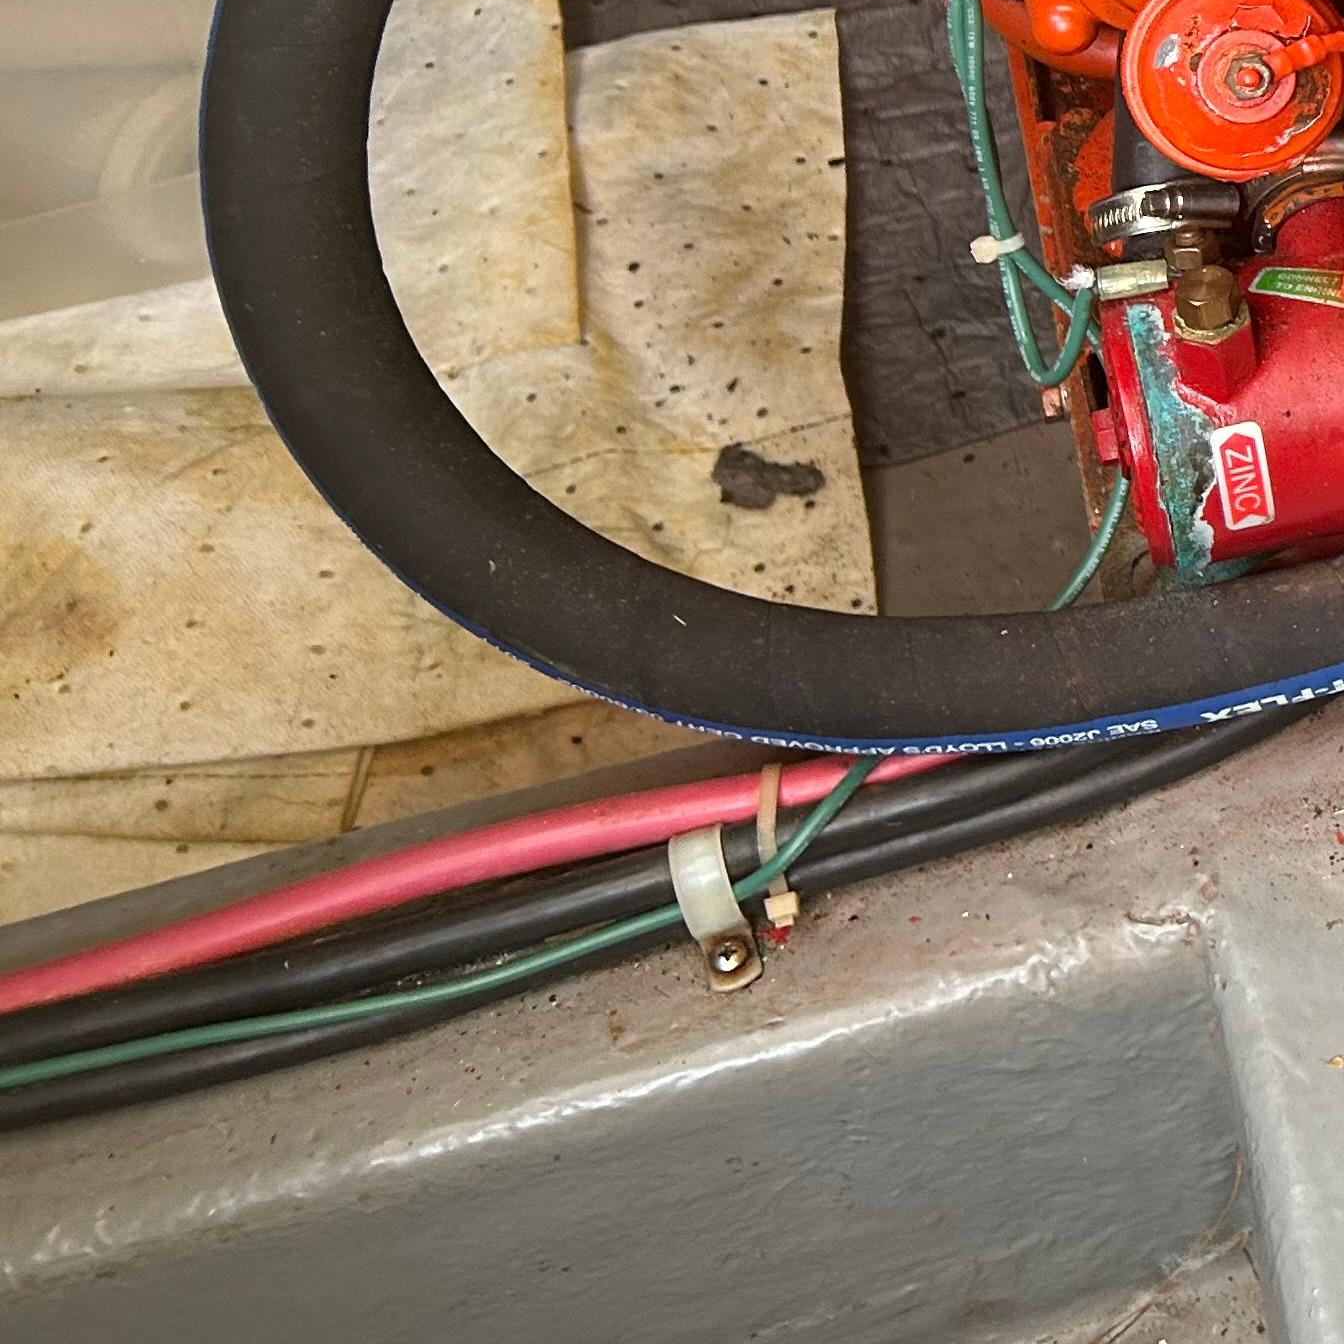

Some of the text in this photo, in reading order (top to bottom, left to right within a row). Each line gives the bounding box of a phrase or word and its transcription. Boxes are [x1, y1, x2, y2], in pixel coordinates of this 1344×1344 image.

[1225, 445, 1260, 511] ZINC
[1106, 717, 1158, 736] SAE
[902, 740, 1006, 756] LLOYD'S
